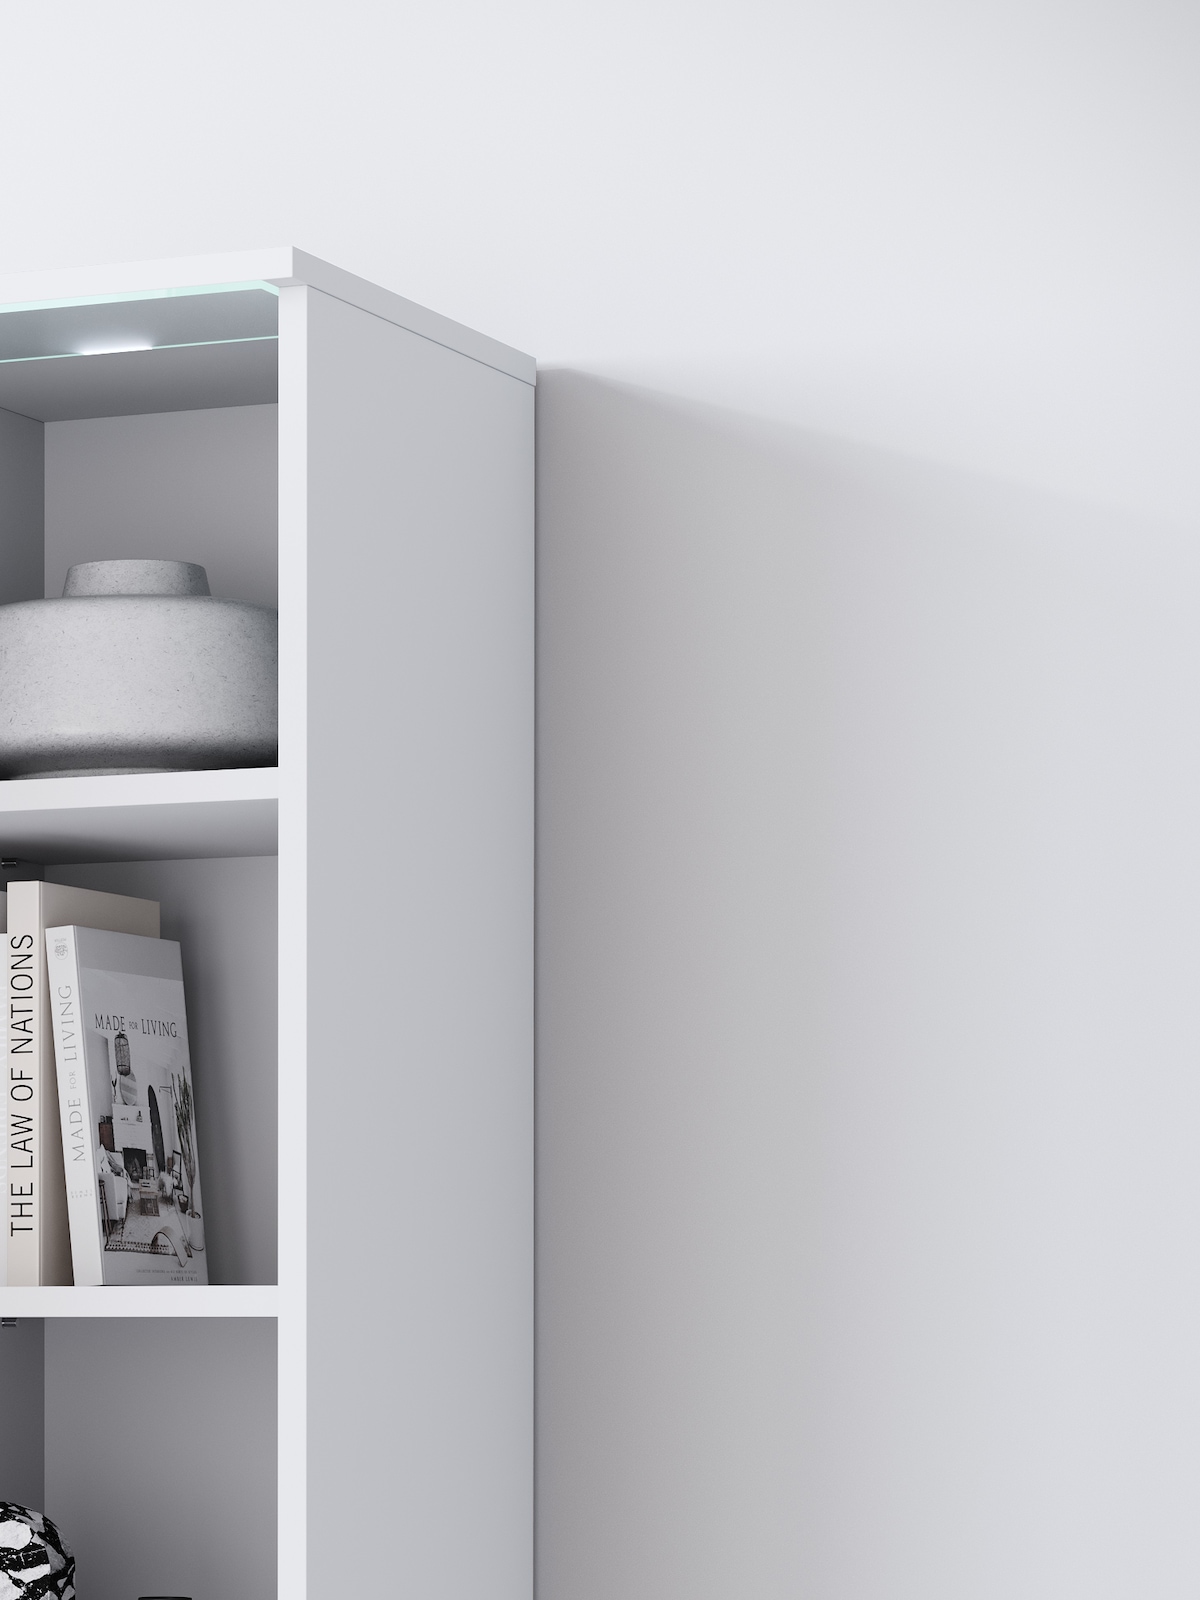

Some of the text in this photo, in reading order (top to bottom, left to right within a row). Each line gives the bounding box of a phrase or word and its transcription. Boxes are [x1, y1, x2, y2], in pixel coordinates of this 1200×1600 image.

[10, 934, 34, 1237] THE LAW OF NATIONS
[57, 984, 86, 1162] MADE FOR LIVING
[94, 1013, 177, 1038] MADE FOR LIVING
